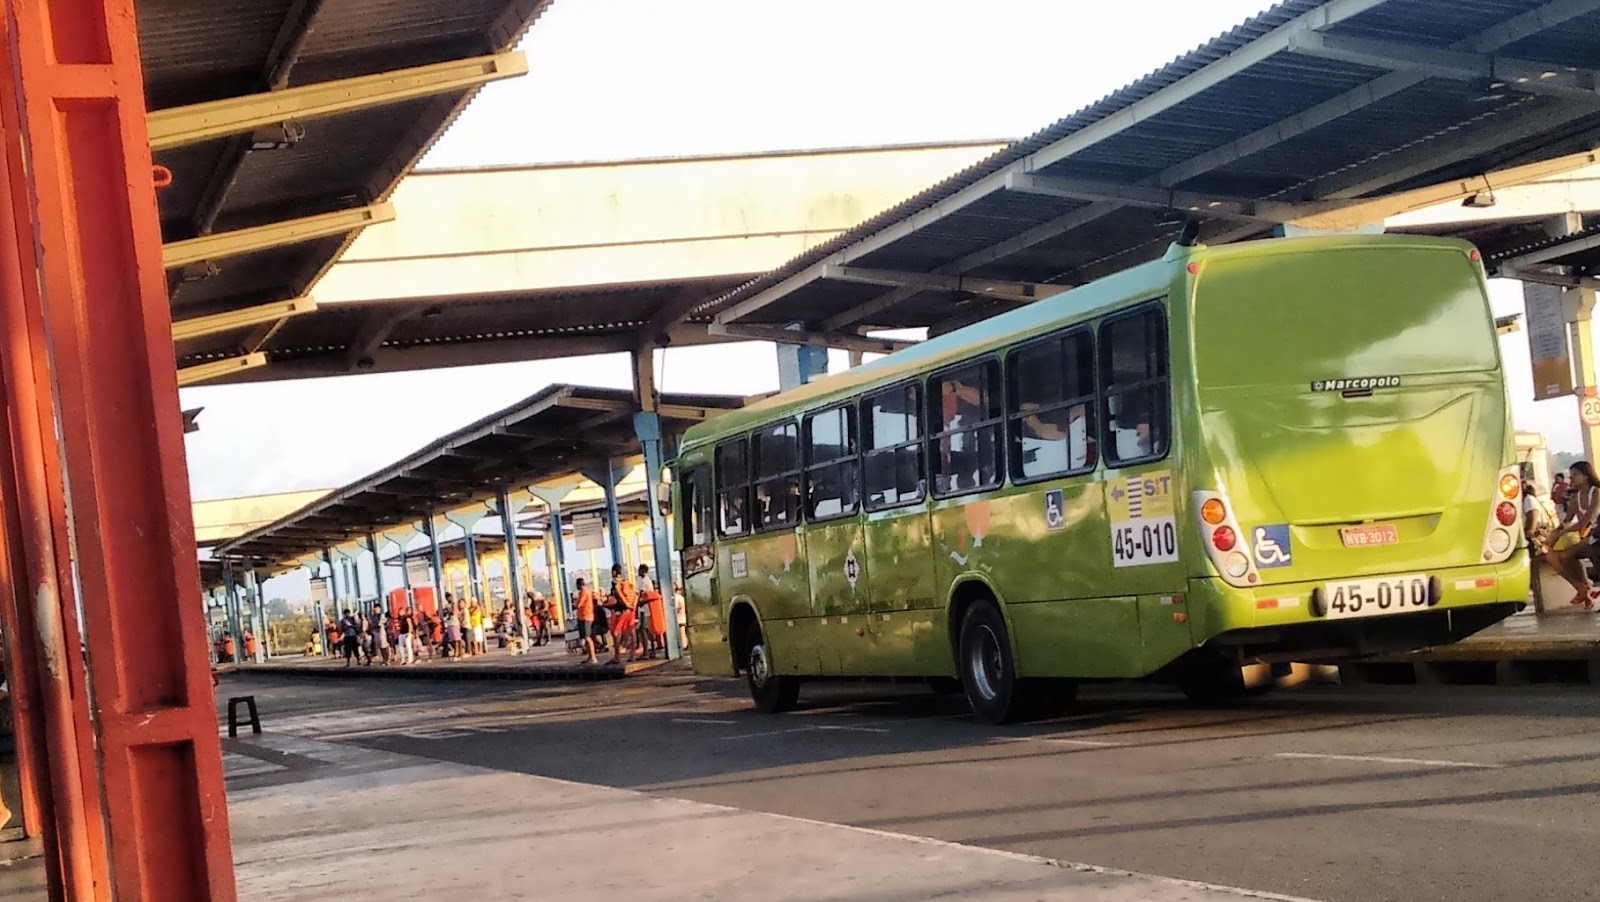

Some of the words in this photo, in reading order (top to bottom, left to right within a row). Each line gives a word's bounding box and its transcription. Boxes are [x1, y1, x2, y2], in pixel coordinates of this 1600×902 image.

[1325, 376, 1400, 391] Marcopolo
[1115, 522, 1175, 560] 45-010
[1331, 578, 1426, 613] 45-010
